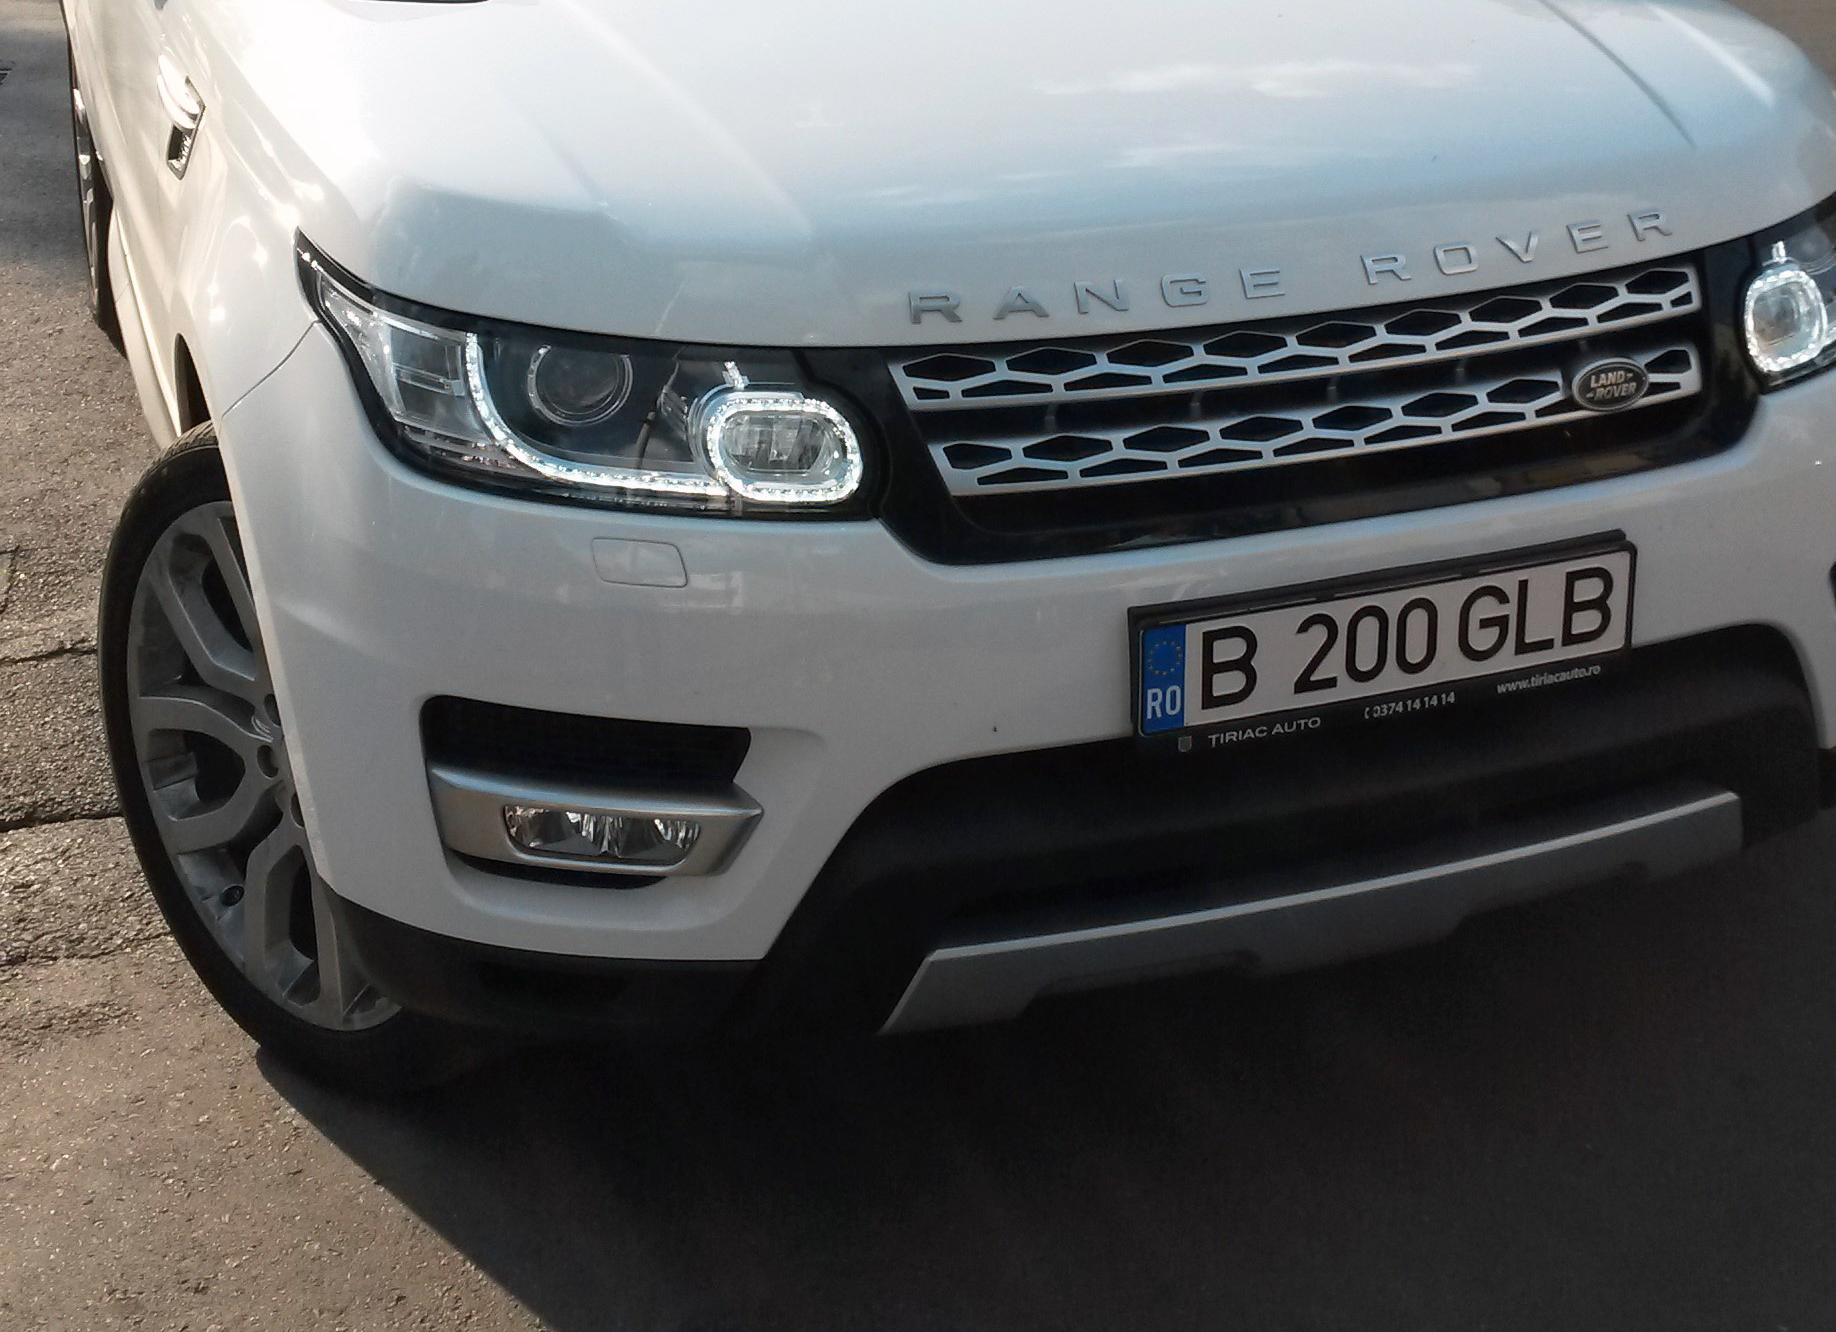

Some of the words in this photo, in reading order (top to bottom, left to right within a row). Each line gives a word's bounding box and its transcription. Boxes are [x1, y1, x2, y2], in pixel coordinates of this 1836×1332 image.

[907, 268, 1286, 325] RANGE
[1360, 208, 1673, 285] ROVER
[1590, 370, 1626, 388] LAND
[1594, 382, 1637, 401] ROVER
[1201, 625, 1258, 710] B
[1293, 596, 1438, 695] 200
[1457, 566, 1614, 663] GLB
[1497, 664, 1601, 694] www.tiriacauto.ro
[1146, 684, 1182, 719] RO
[1373, 702, 1403, 718] 0374
[1407, 698, 1421, 712] 14
[1424, 696, 1438, 709] 14
[1441, 692, 1455, 705] 14
[1208, 726, 1267, 748] TIRIAC
[1271, 717, 1321, 735] AUTO
